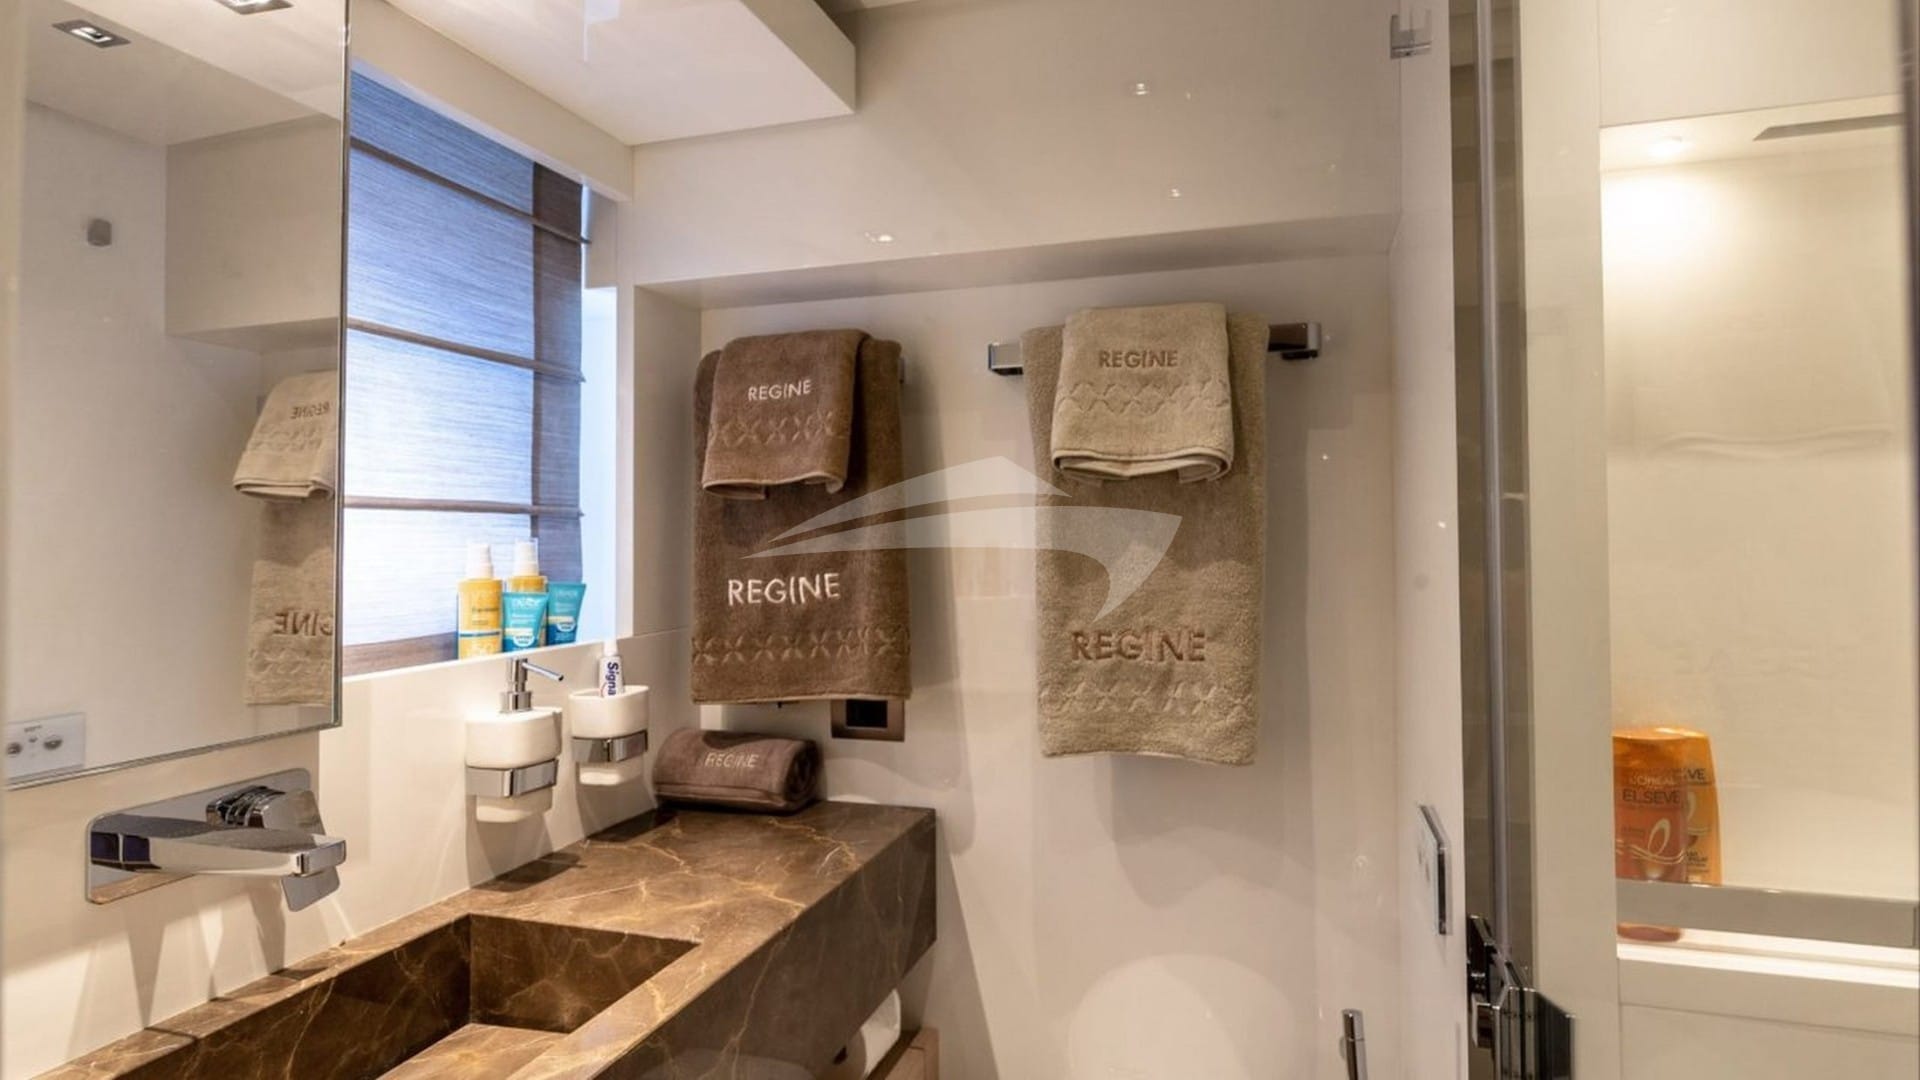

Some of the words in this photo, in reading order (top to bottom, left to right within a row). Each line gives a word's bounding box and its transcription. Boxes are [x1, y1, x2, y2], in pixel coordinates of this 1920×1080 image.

[1100, 350, 1179, 368] REGINE
[748, 379, 812, 402] REGINE
[727, 572, 841, 606] REGINE
[1070, 629, 1206, 662] REGINE
[704, 751, 760, 768] REGINE
[1622, 788, 1681, 804] ELSEVE
